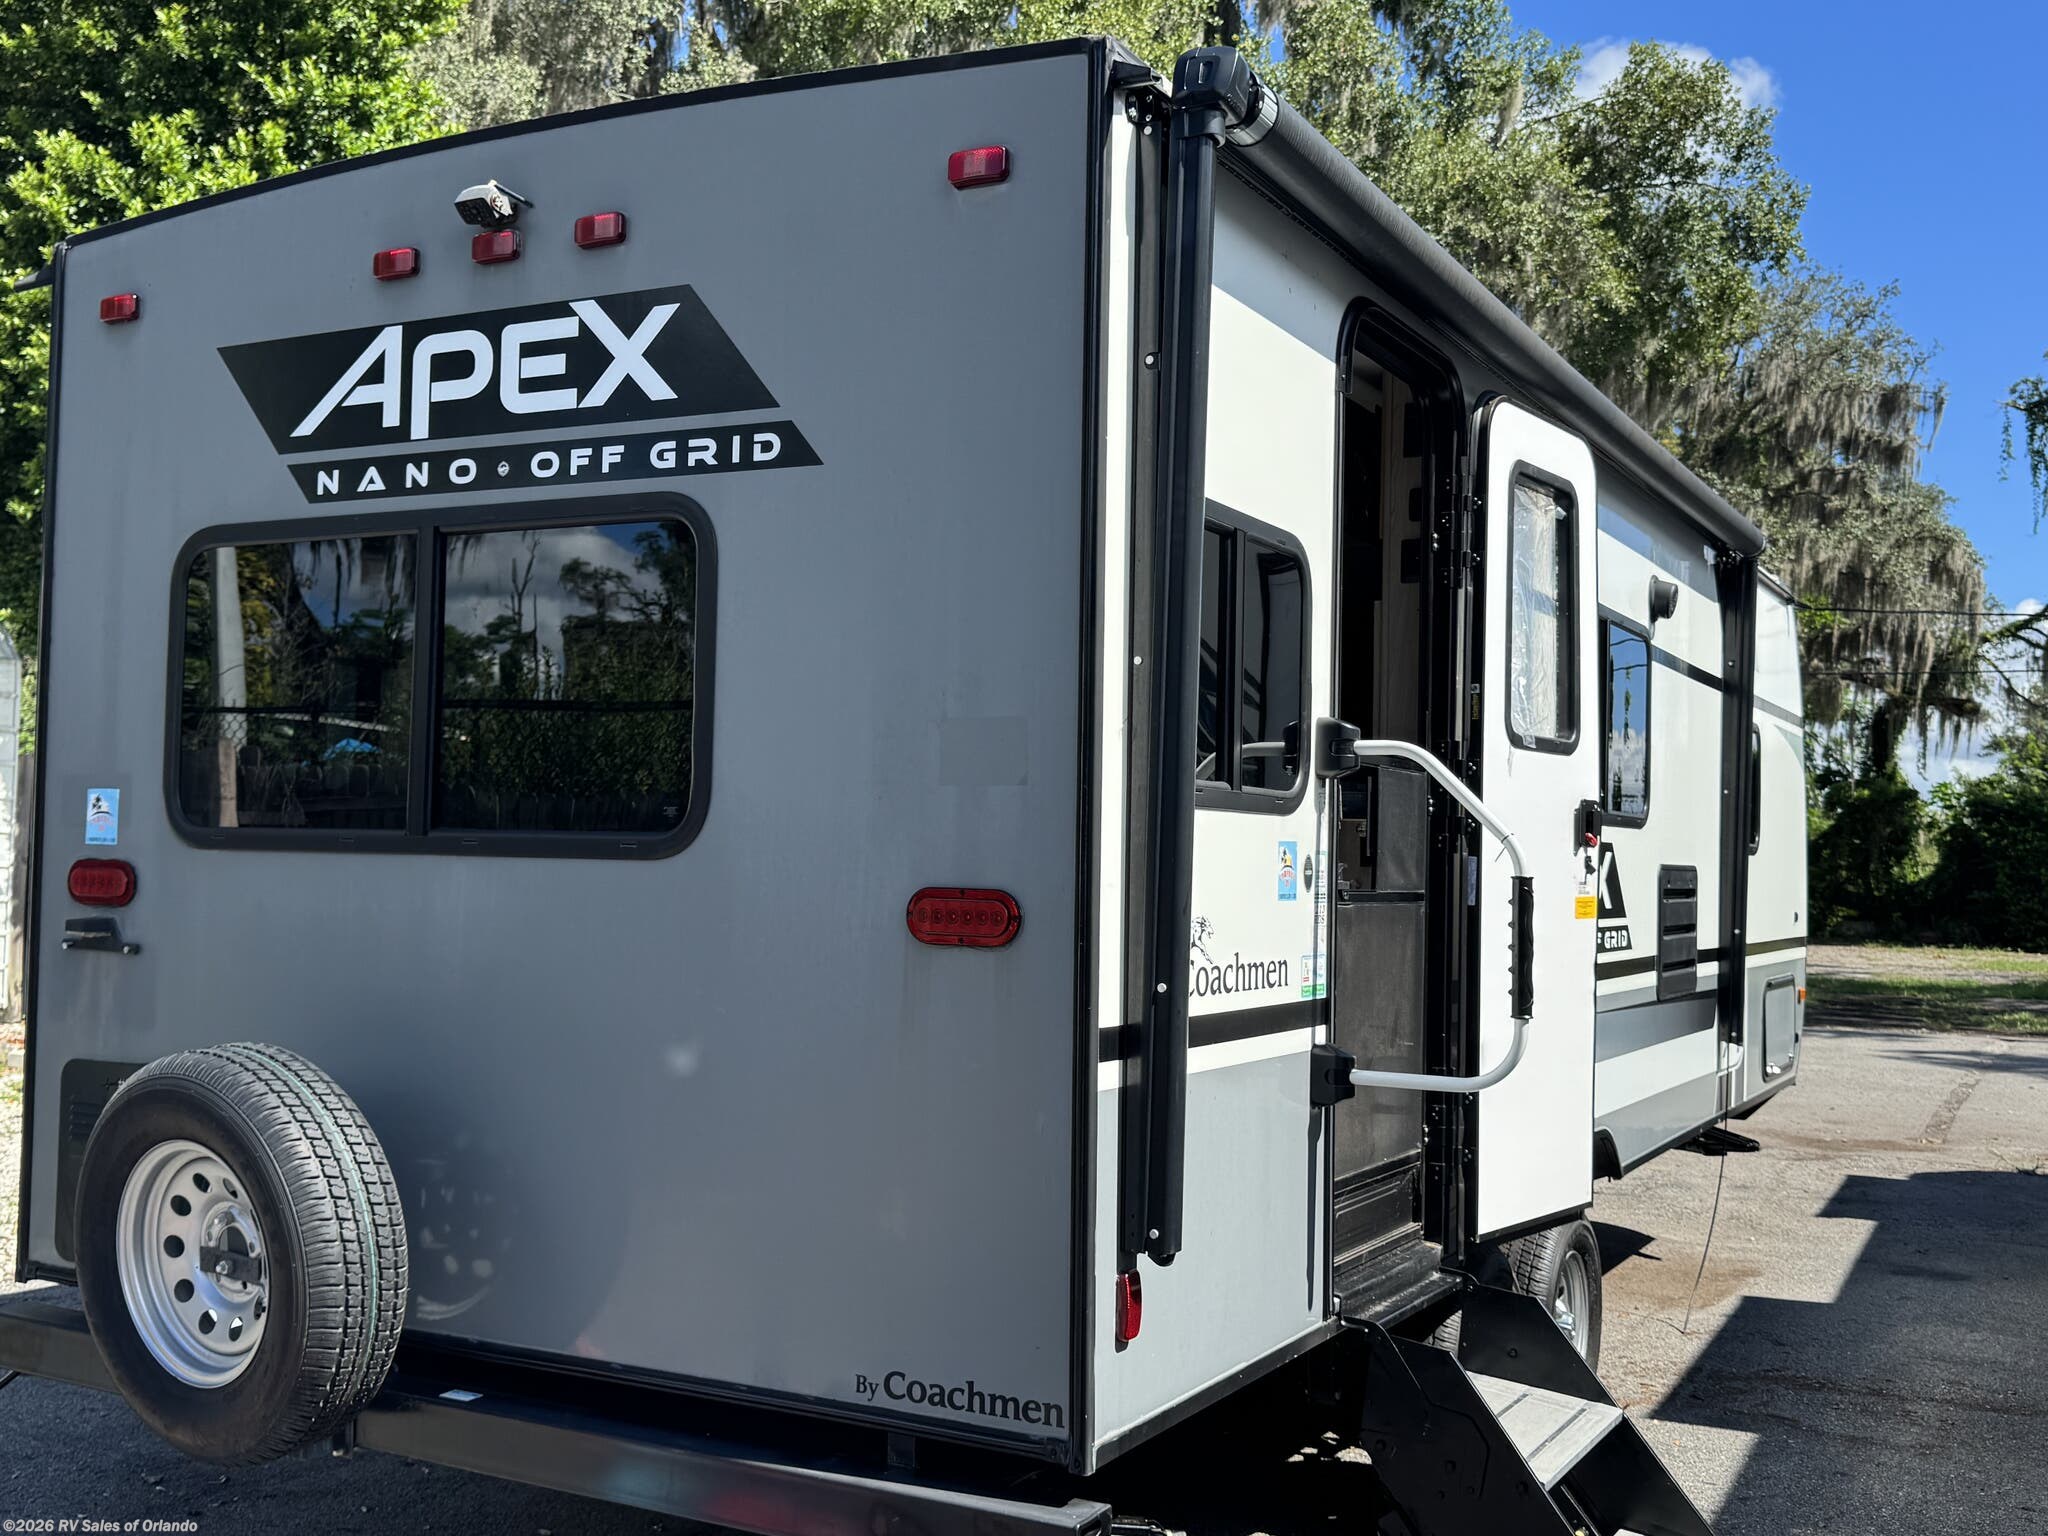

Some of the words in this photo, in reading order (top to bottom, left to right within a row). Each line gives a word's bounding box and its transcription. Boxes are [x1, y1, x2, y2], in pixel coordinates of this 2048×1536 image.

[289, 299, 681, 440] APEX
[316, 456, 477, 496] NANO
[529, 443, 625, 479] OFF
[649, 431, 782, 470] GRID
[1604, 929, 1628, 949] GRID
[855, 1374, 879, 1402] By
[883, 1370, 1065, 1429] Coachmen
